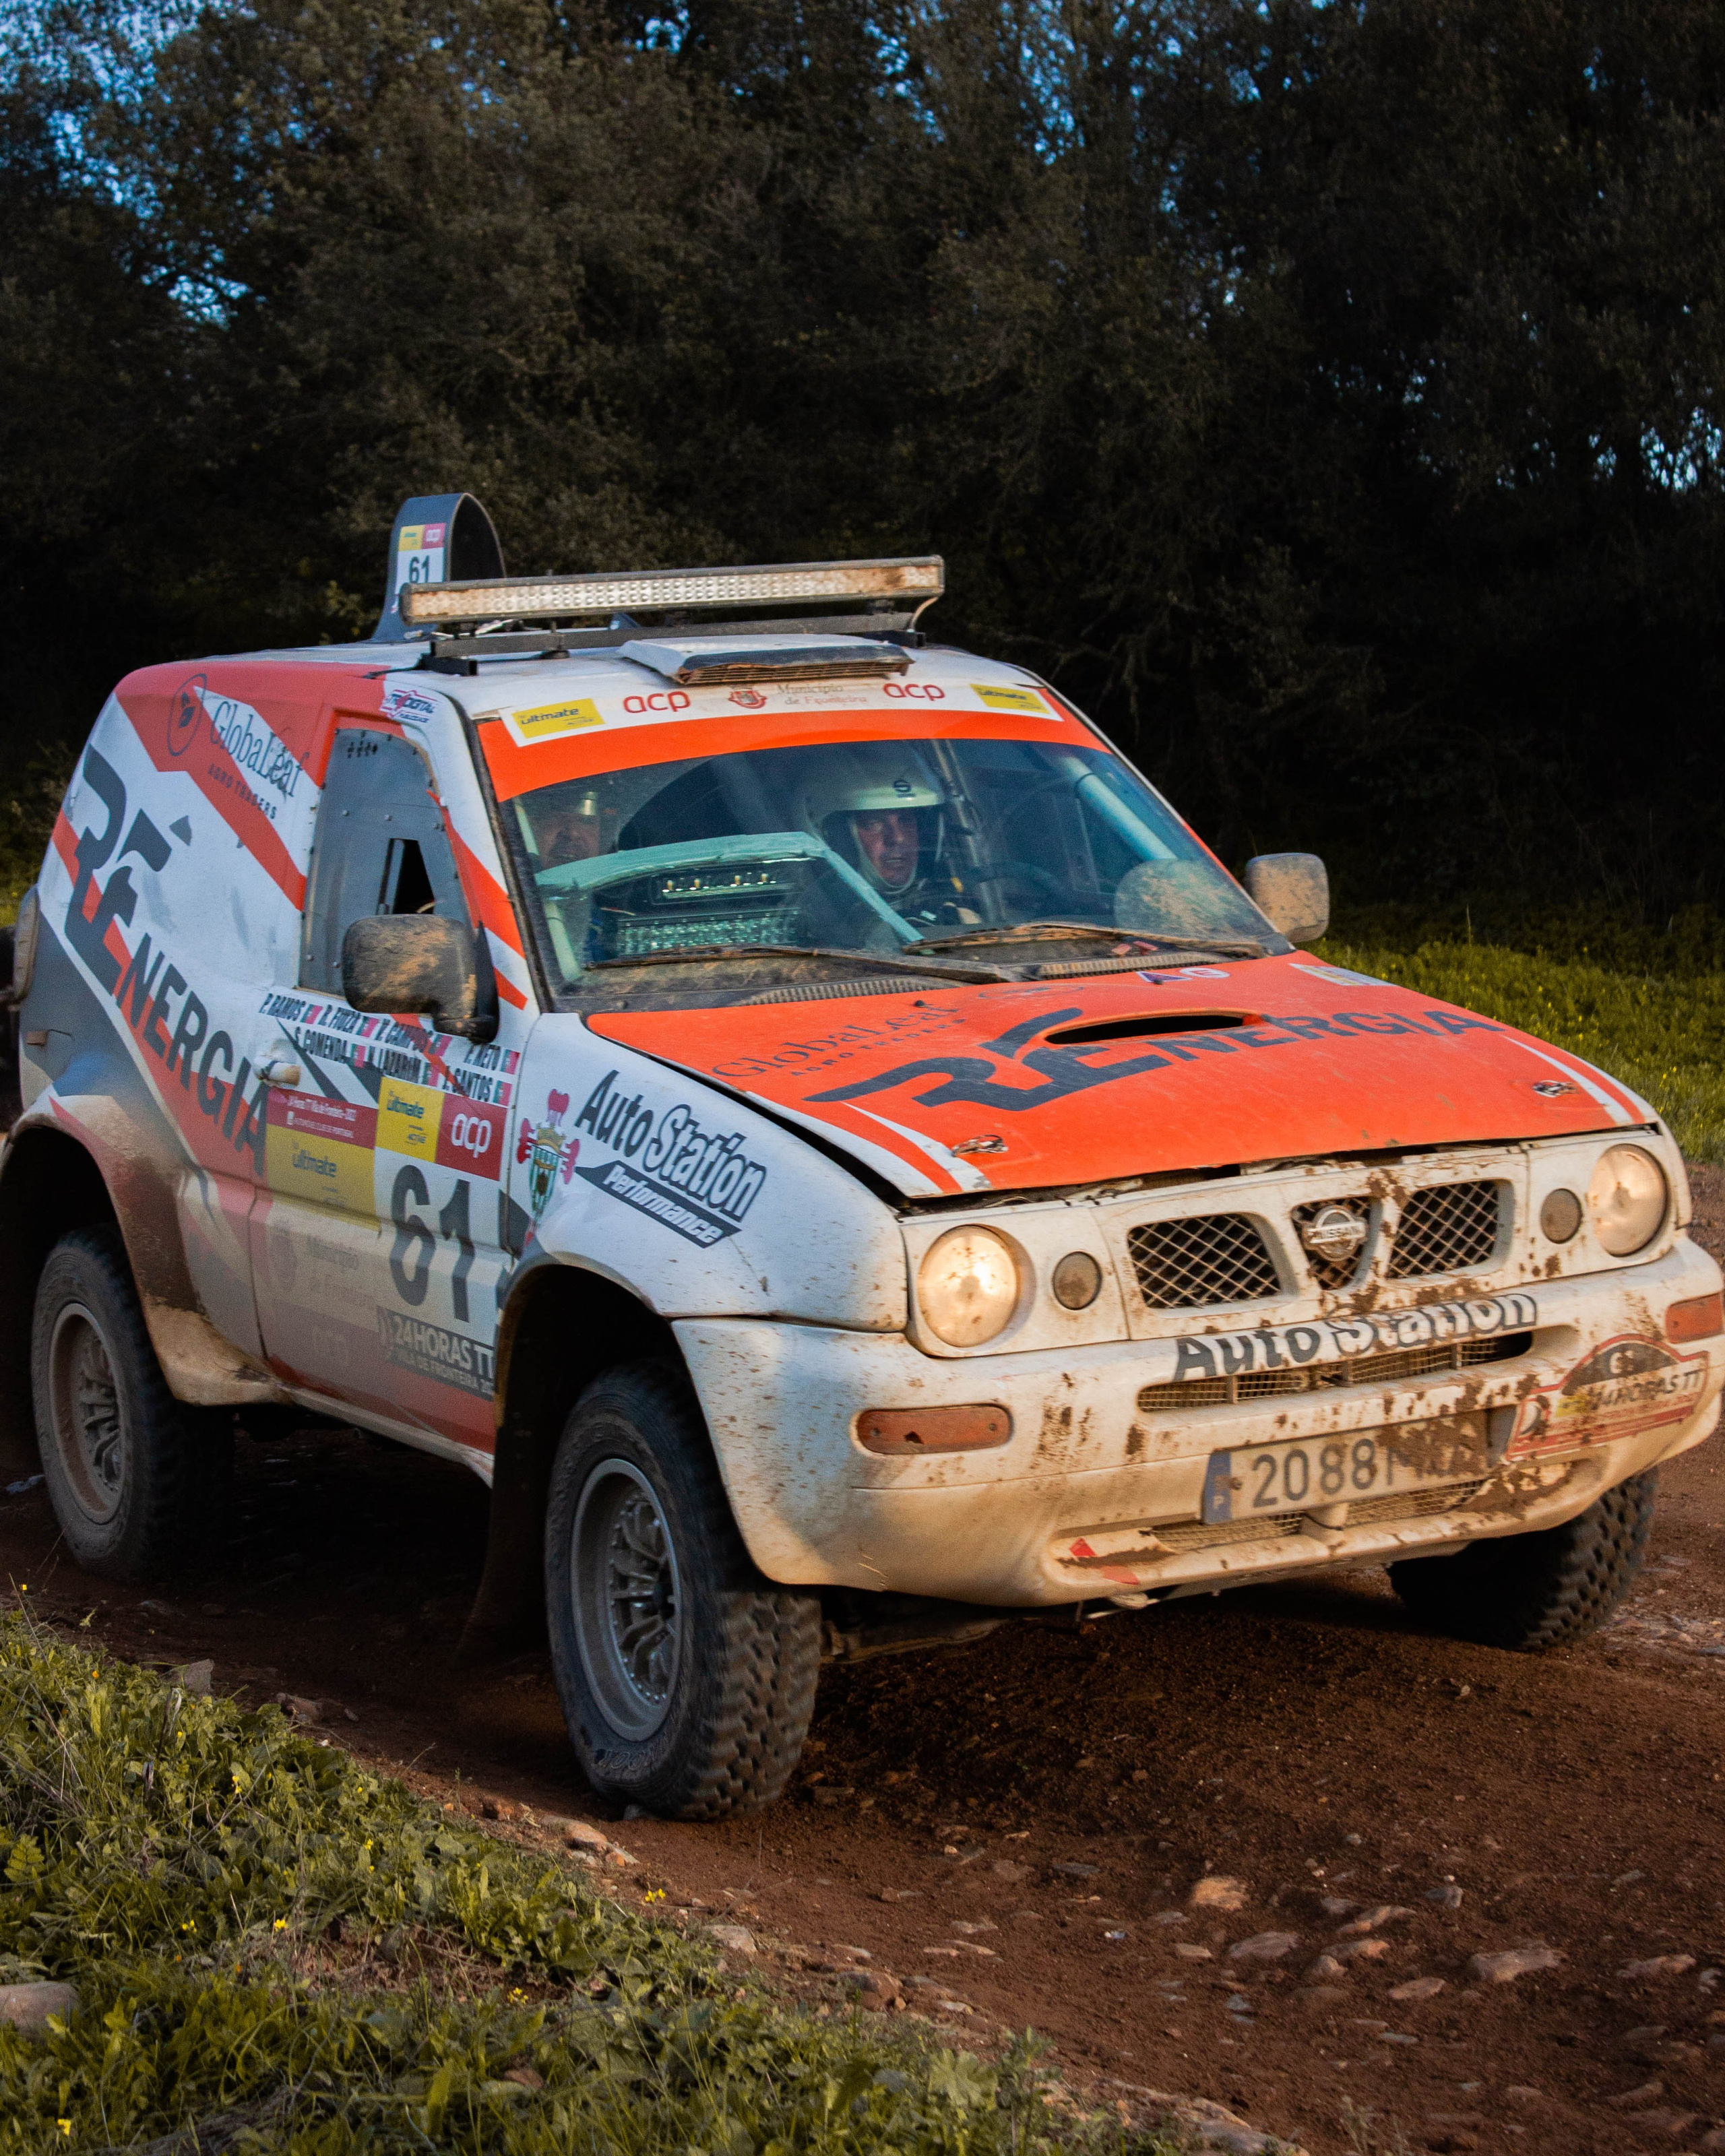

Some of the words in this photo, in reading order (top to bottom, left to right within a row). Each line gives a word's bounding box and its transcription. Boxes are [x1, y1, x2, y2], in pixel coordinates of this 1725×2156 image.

[408, 555, 430, 583] 61
[623, 691, 691, 714] acp
[883, 683, 945, 702] acp
[520, 708, 579, 725] ultimate
[451, 1112, 492, 1159] acp
[602, 1164, 725, 1244] Performance
[389, 1164, 476, 1324] 61
